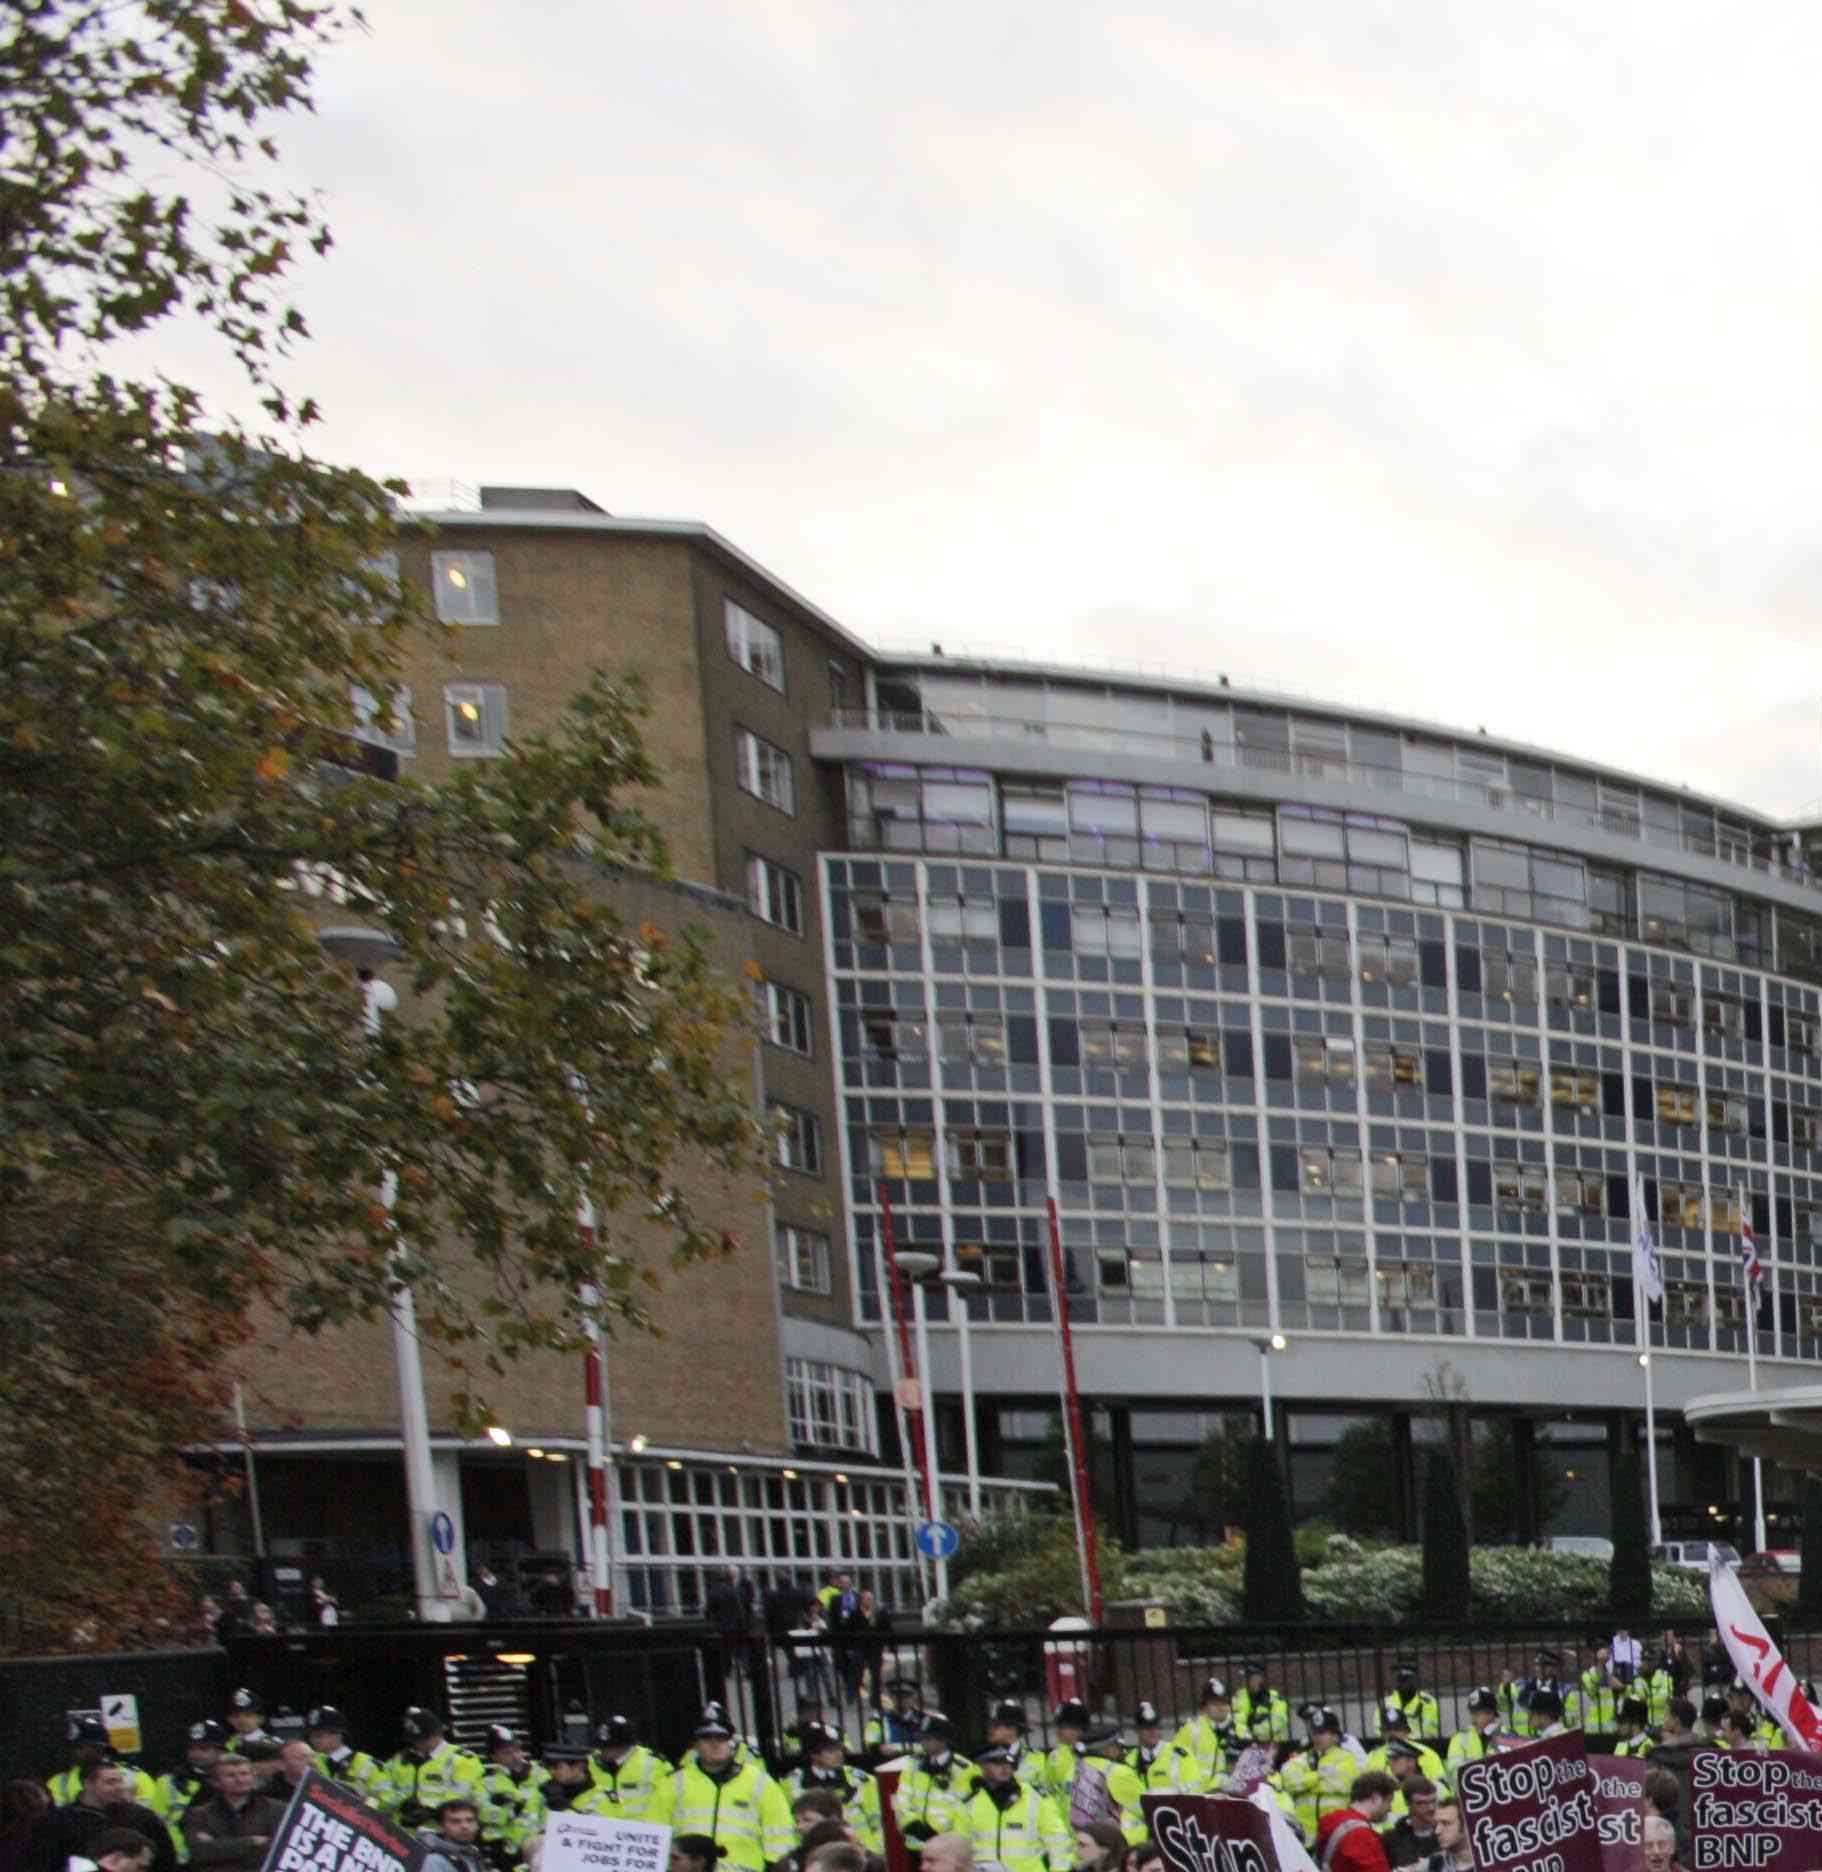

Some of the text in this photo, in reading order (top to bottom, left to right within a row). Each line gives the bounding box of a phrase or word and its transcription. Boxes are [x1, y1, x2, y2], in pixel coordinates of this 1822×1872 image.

[1462, 1757, 1588, 1811] Stop the
[1692, 1753, 1789, 1794] Stop
[301, 1802, 354, 1846] THE
[616, 1831, 660, 1845] UNITE
[1474, 1791, 1595, 1865] fascist
[290, 1825, 314, 1855] IS
[315, 1844, 338, 1867] A
[561, 1838, 658, 1858] & FIGHT FOR
[582, 1855, 656, 1870] JOBS FOR
[1694, 1834, 1782, 1869] BNP
